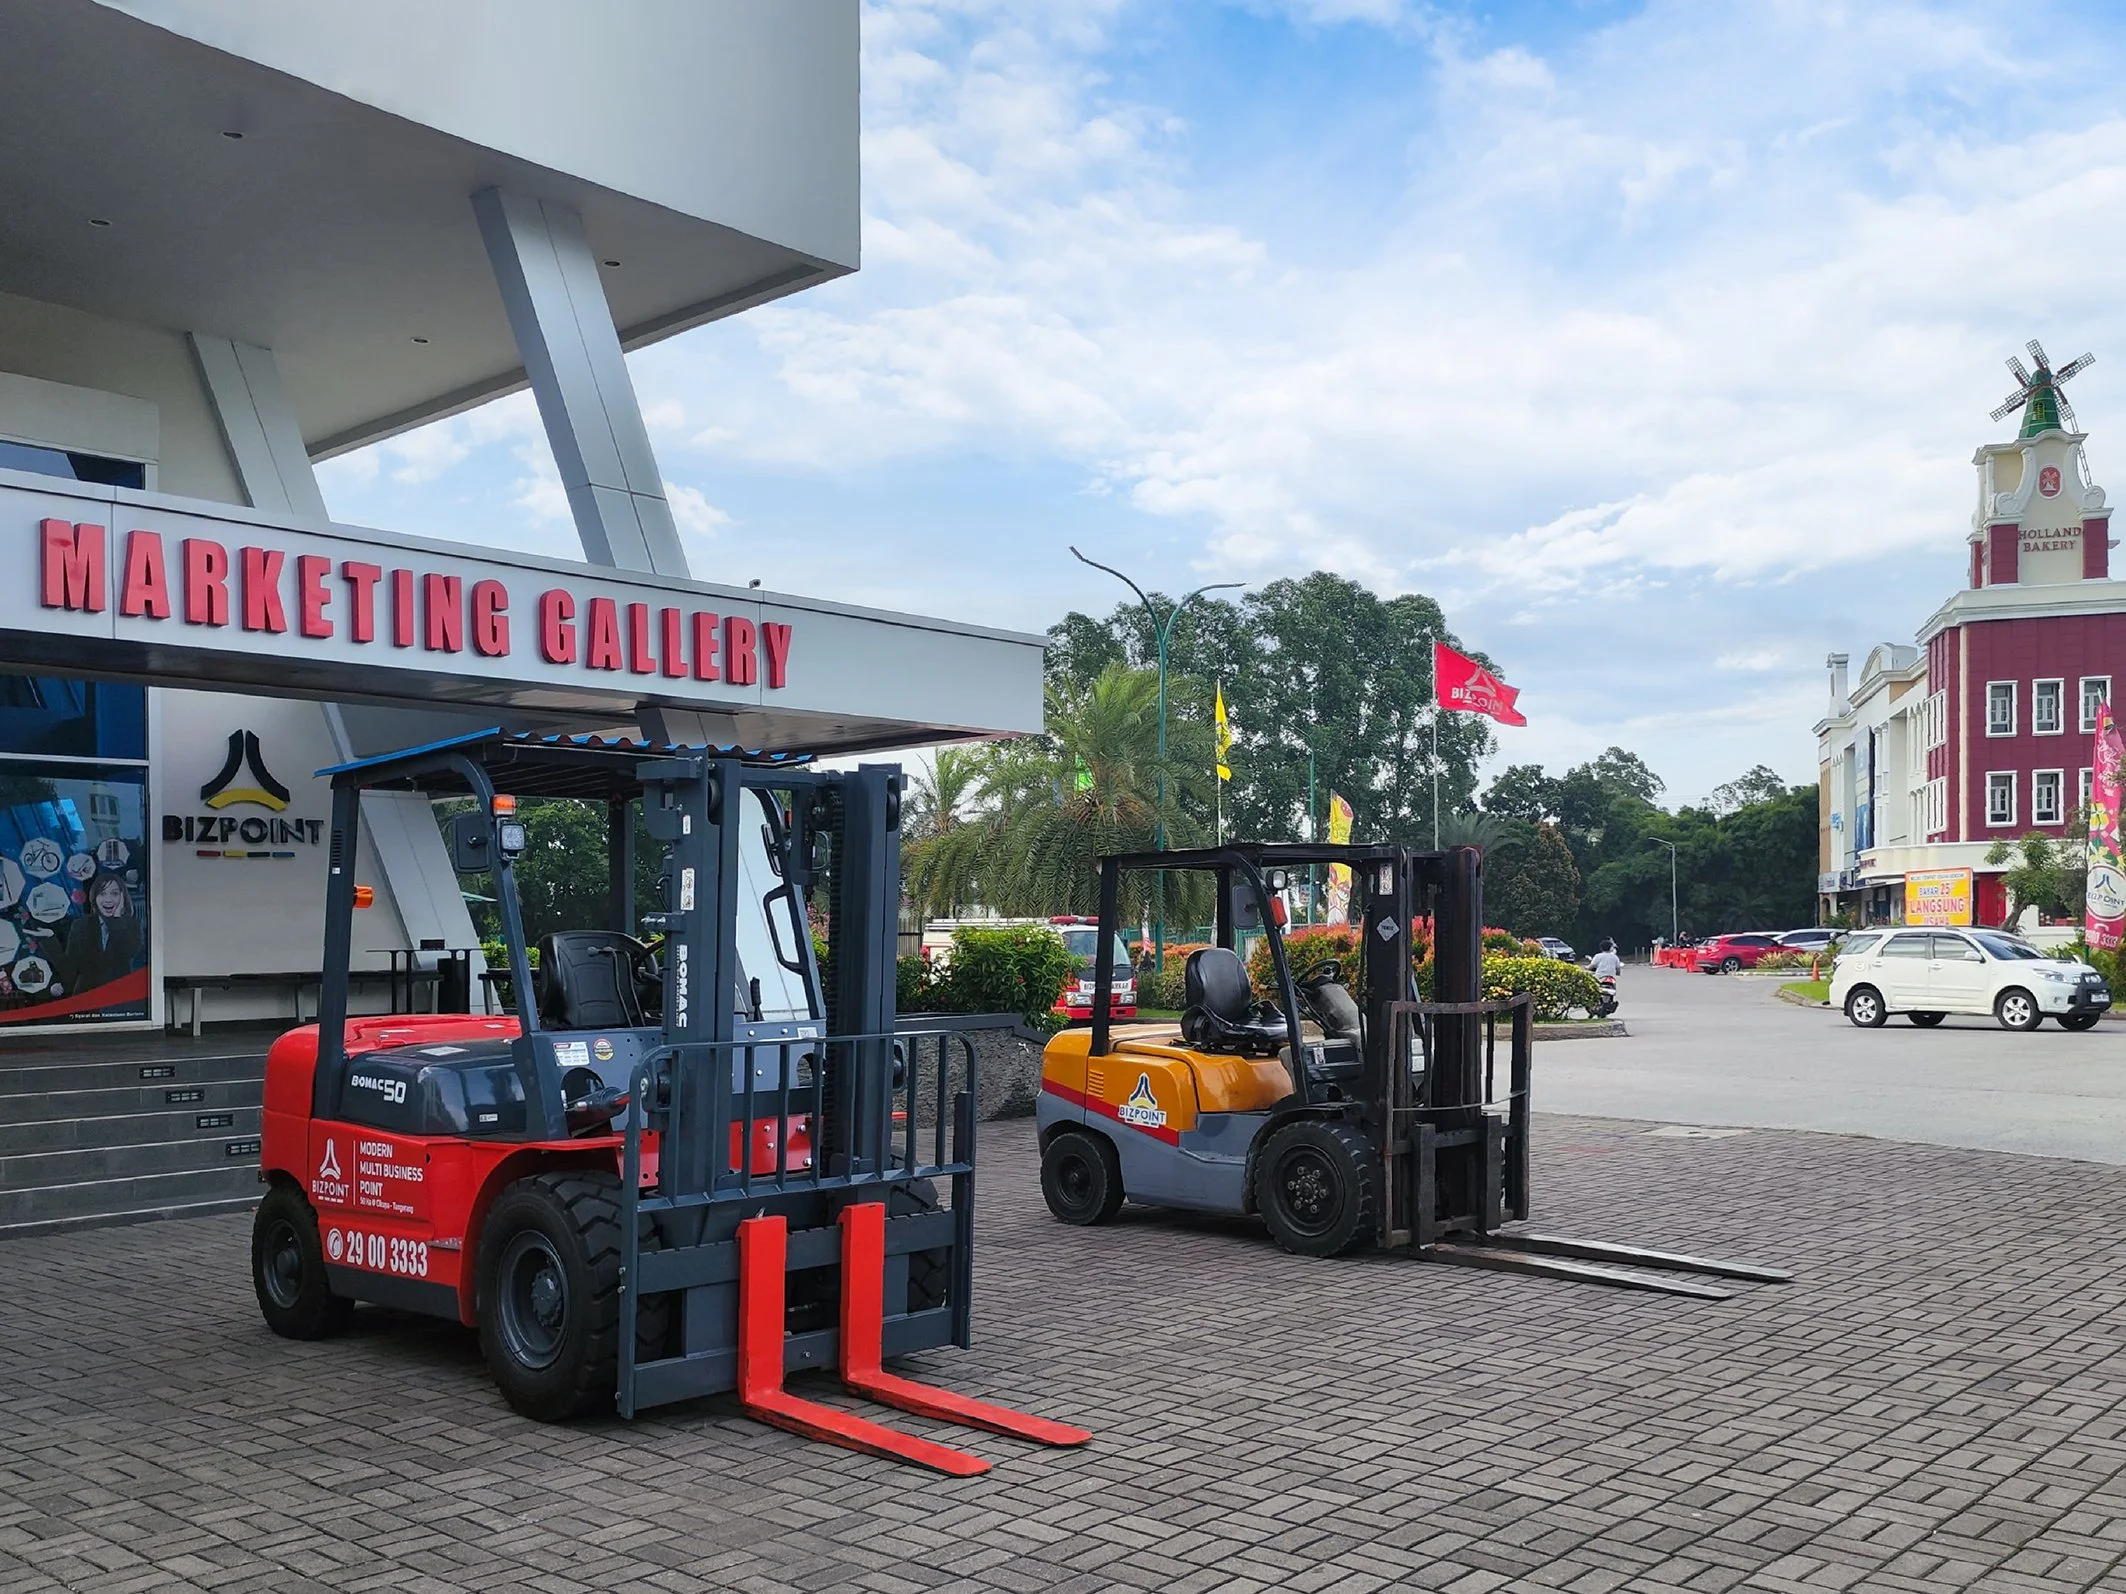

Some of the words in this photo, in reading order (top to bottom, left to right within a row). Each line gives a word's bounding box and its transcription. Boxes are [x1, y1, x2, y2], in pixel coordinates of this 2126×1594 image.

[2018, 527, 2082, 540] HOLLAND
[2023, 540, 2076, 552] BAKERY
[40, 518, 510, 657] MARKETING
[539, 588, 792, 689] GALLERY
[162, 815, 324, 844] BIZPOINT
[1919, 887, 1938, 896] BAYAR
[1940, 882, 1950, 895] 25
[1910, 898, 1964, 914] LANGSUNG
[678, 944, 688, 1028] BOMAC
[351, 1074, 384, 1091] BOMAC
[383, 1079, 407, 1104] 50
[1119, 1106, 1166, 1125] BIZPOINT
[360, 1141, 393, 1158] MODERN
[360, 1161, 382, 1176] MULTI
[383, 1165, 423, 1182] BUSINESS
[312, 1180, 350, 1198] BIZPOINT
[360, 1180, 383, 1197] POINT
[346, 1230, 364, 1266] 29
[368, 1234, 386, 1270] 00
[390, 1237, 428, 1277] 3333
